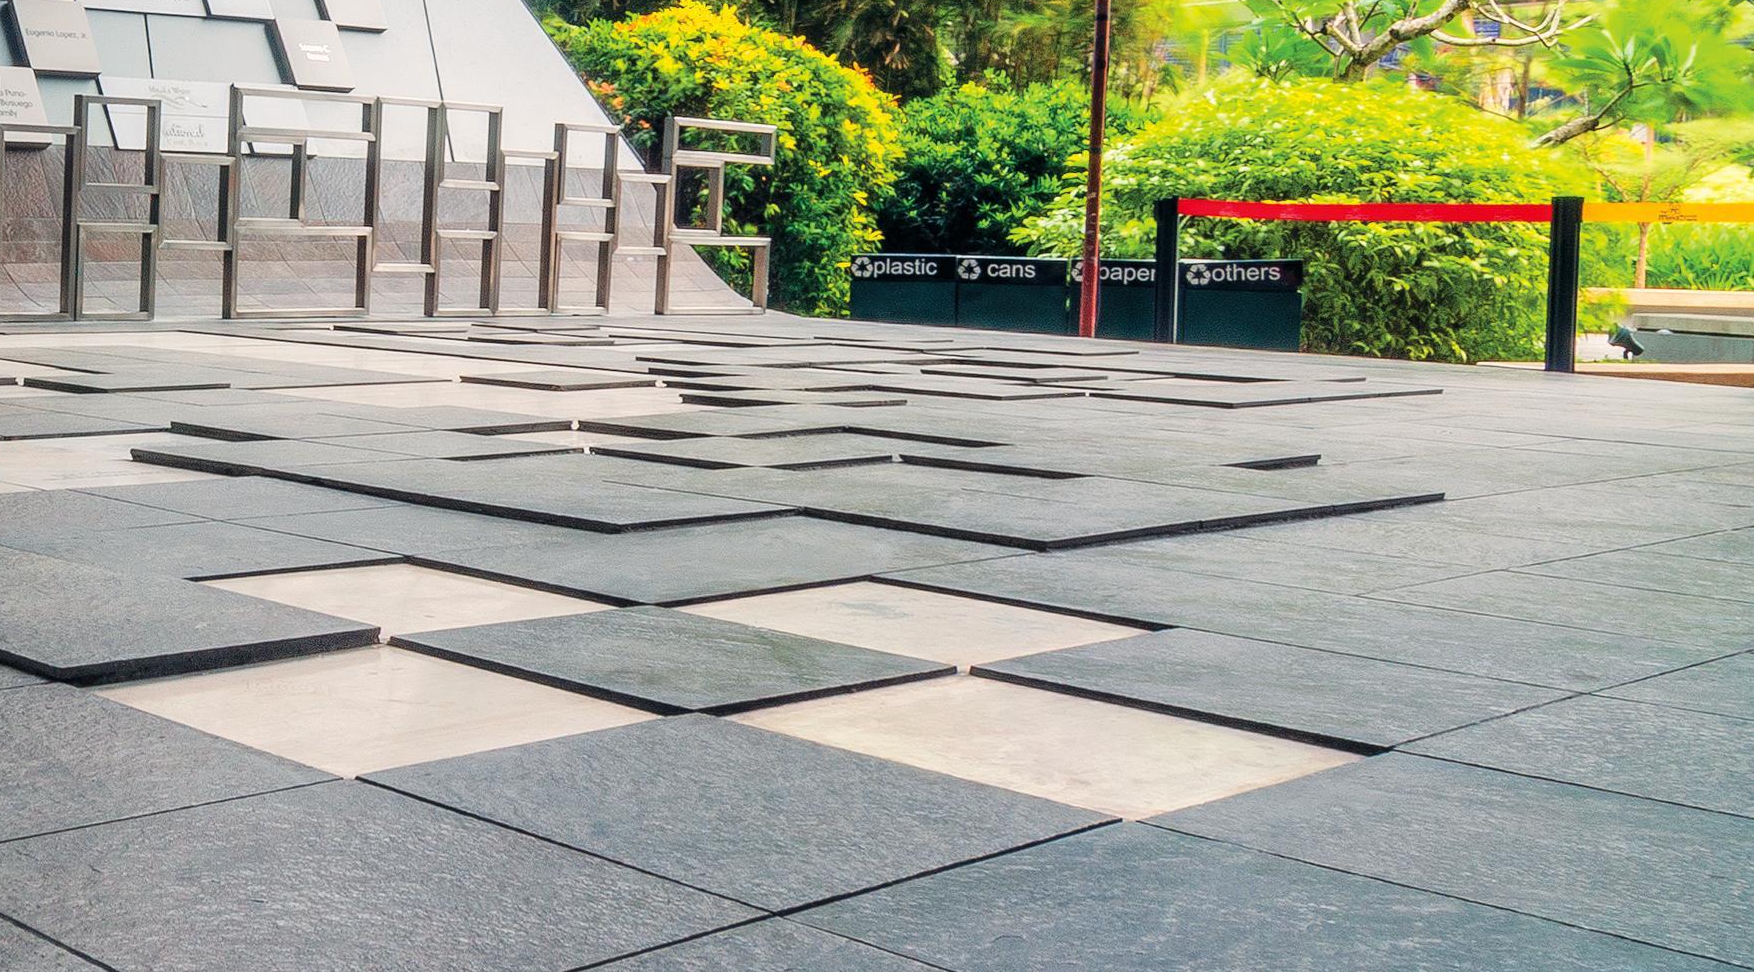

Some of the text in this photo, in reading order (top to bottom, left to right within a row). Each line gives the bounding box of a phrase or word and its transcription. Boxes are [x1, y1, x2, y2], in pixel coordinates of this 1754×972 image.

[25, 27, 54, 37] Eugenio
[873, 257, 938, 276] plastic
[987, 263, 1036, 279] cans
[1212, 263, 1281, 282] others
